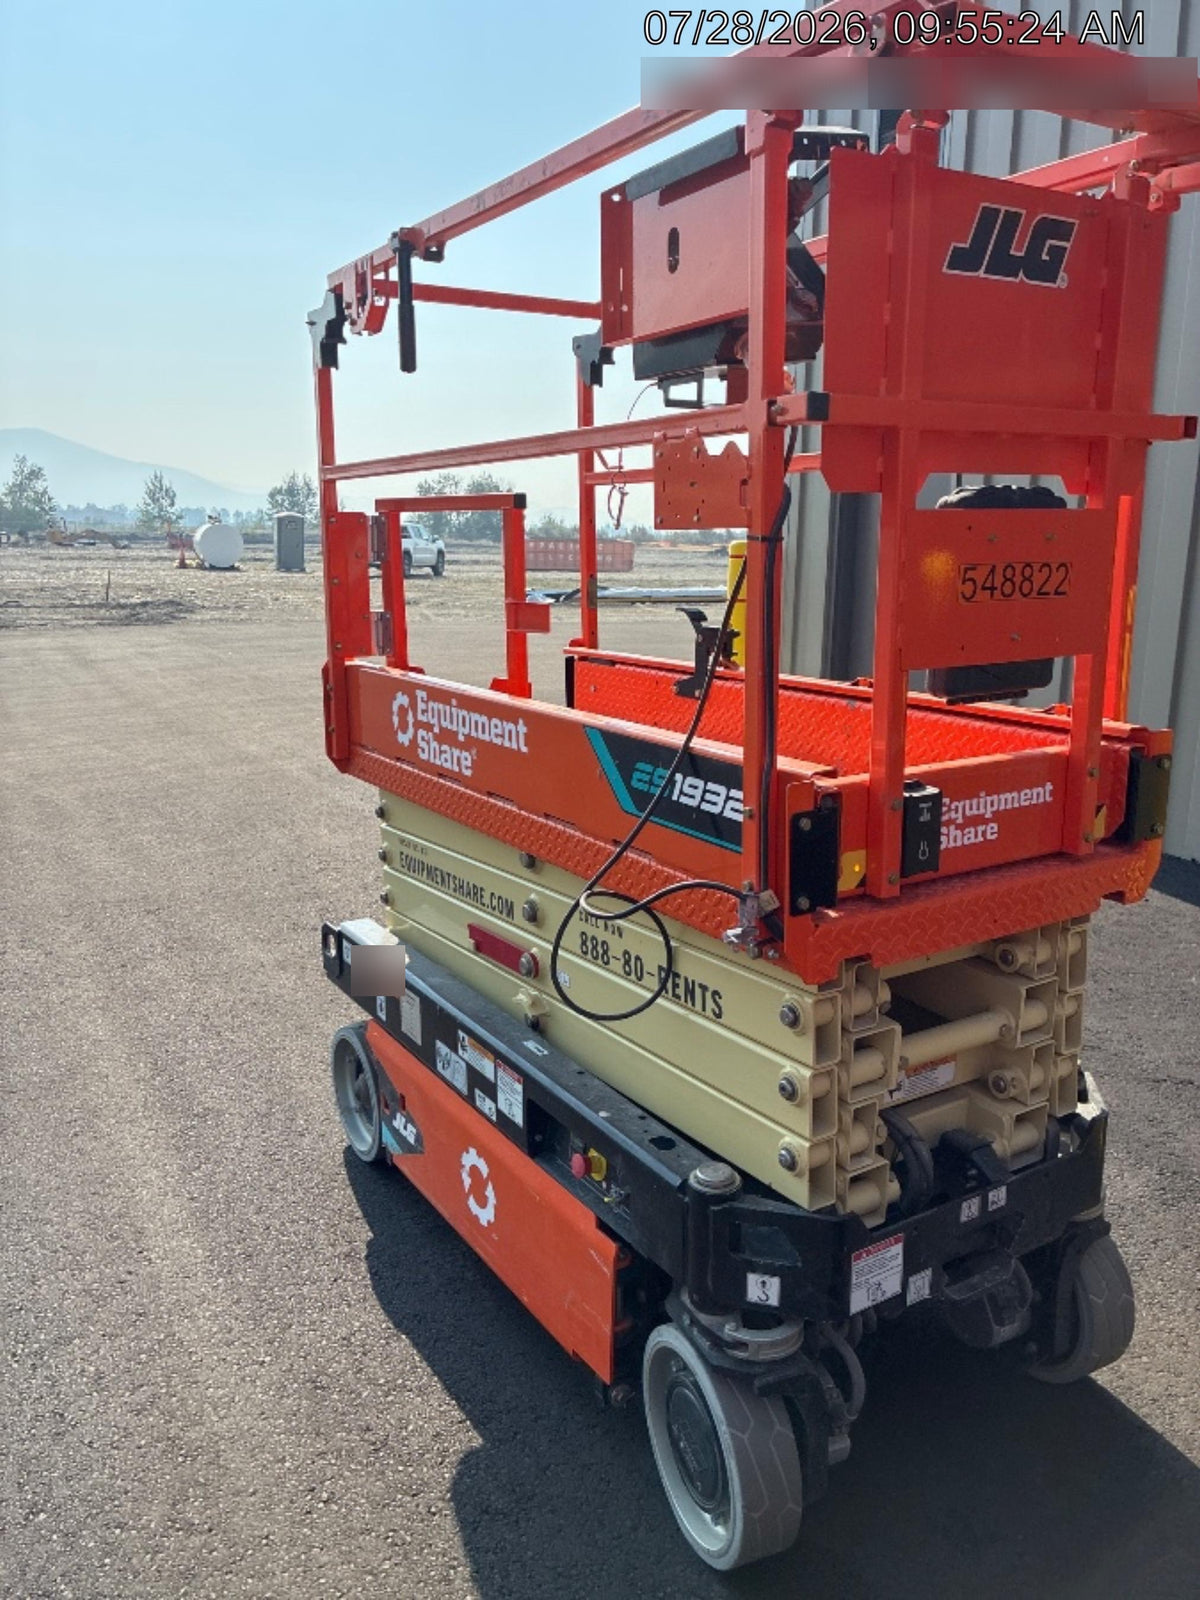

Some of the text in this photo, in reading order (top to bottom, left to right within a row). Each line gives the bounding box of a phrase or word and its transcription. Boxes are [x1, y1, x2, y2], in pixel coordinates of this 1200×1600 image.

[942, 203, 1079, 287] JLG
[960, 563, 1070, 601] 548822
[416, 689, 529, 753] Equipment
[417, 728, 473, 777] Share
[399, 851, 515, 921] EQUIPMENTSHARE.COM
[392, 1112, 417, 1146] JLG
